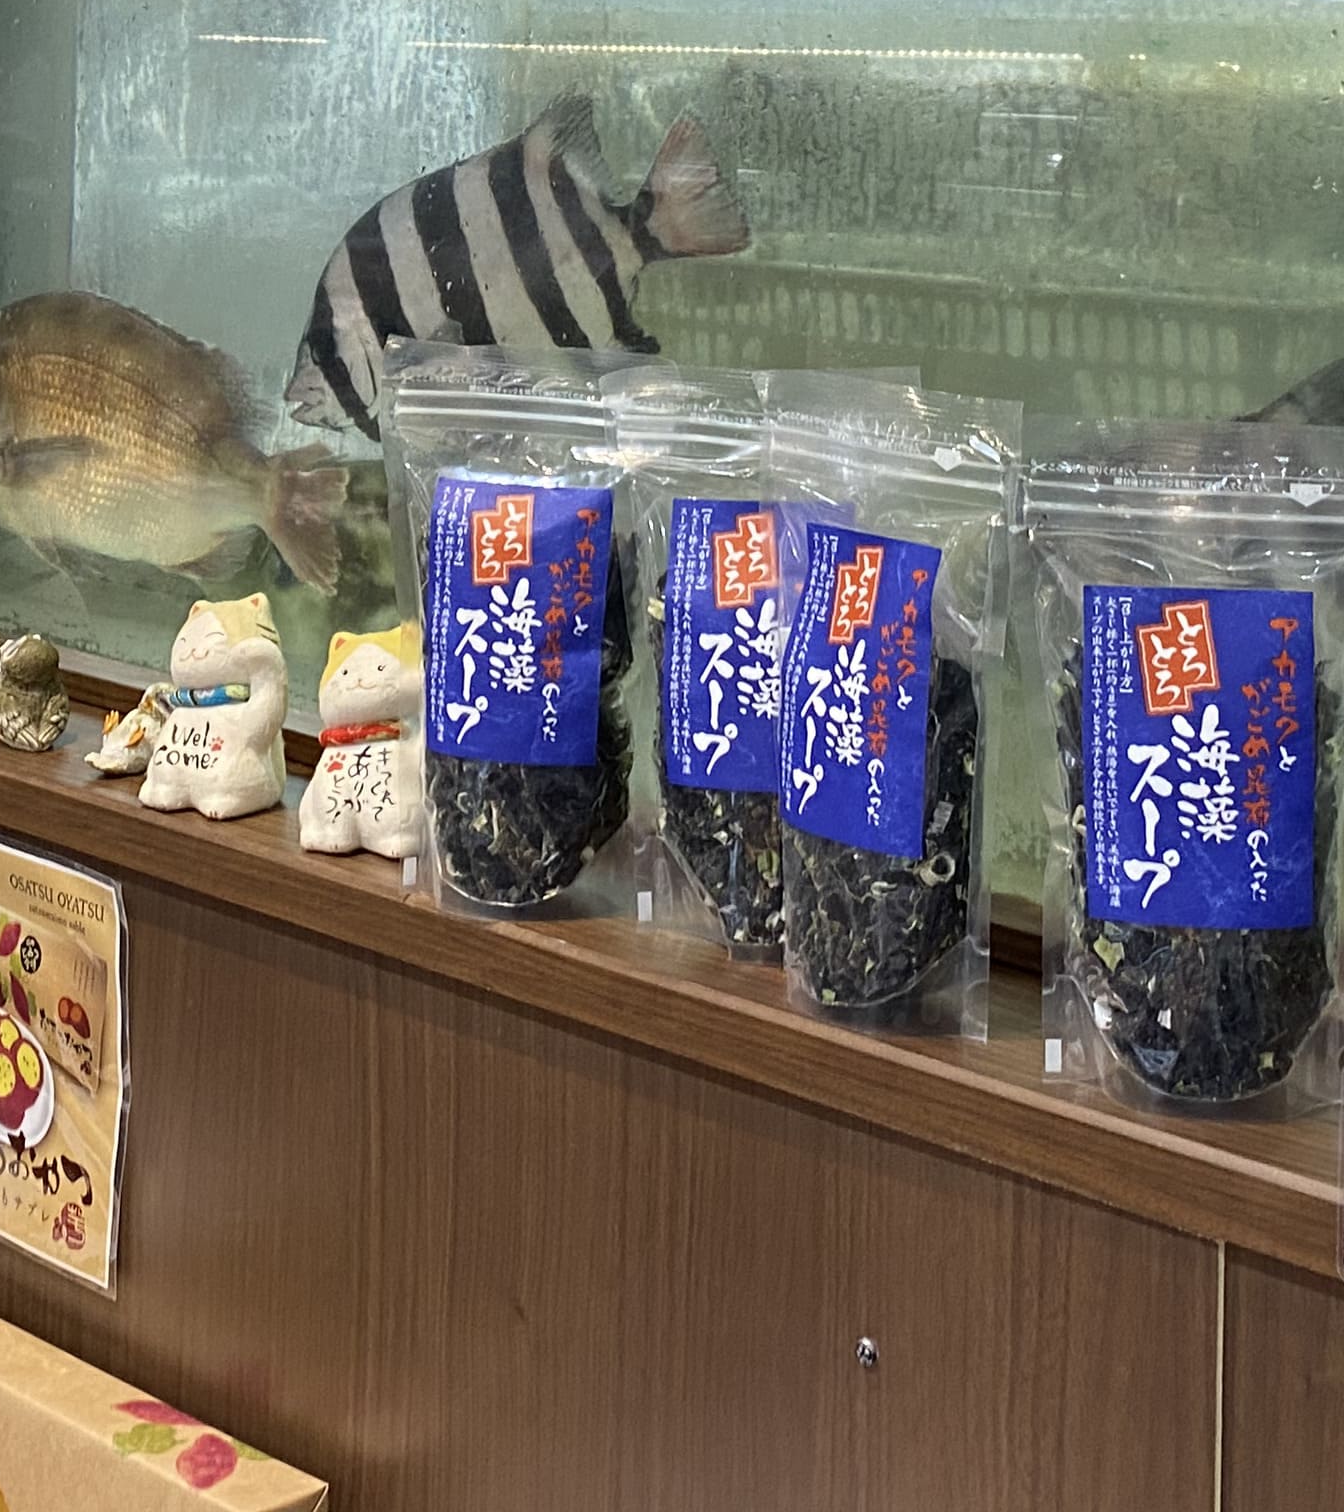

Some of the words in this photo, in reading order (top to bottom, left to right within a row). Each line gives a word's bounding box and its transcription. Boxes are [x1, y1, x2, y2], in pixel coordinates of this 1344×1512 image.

[446, 607, 489, 744] スープ
[692, 632, 739, 777] スープ
[793, 665, 832, 815] スープ
[9, 872, 54, 904] OSATSU
[57, 891, 106, 923] OYATSU
[1123, 744, 1180, 909] スープ
